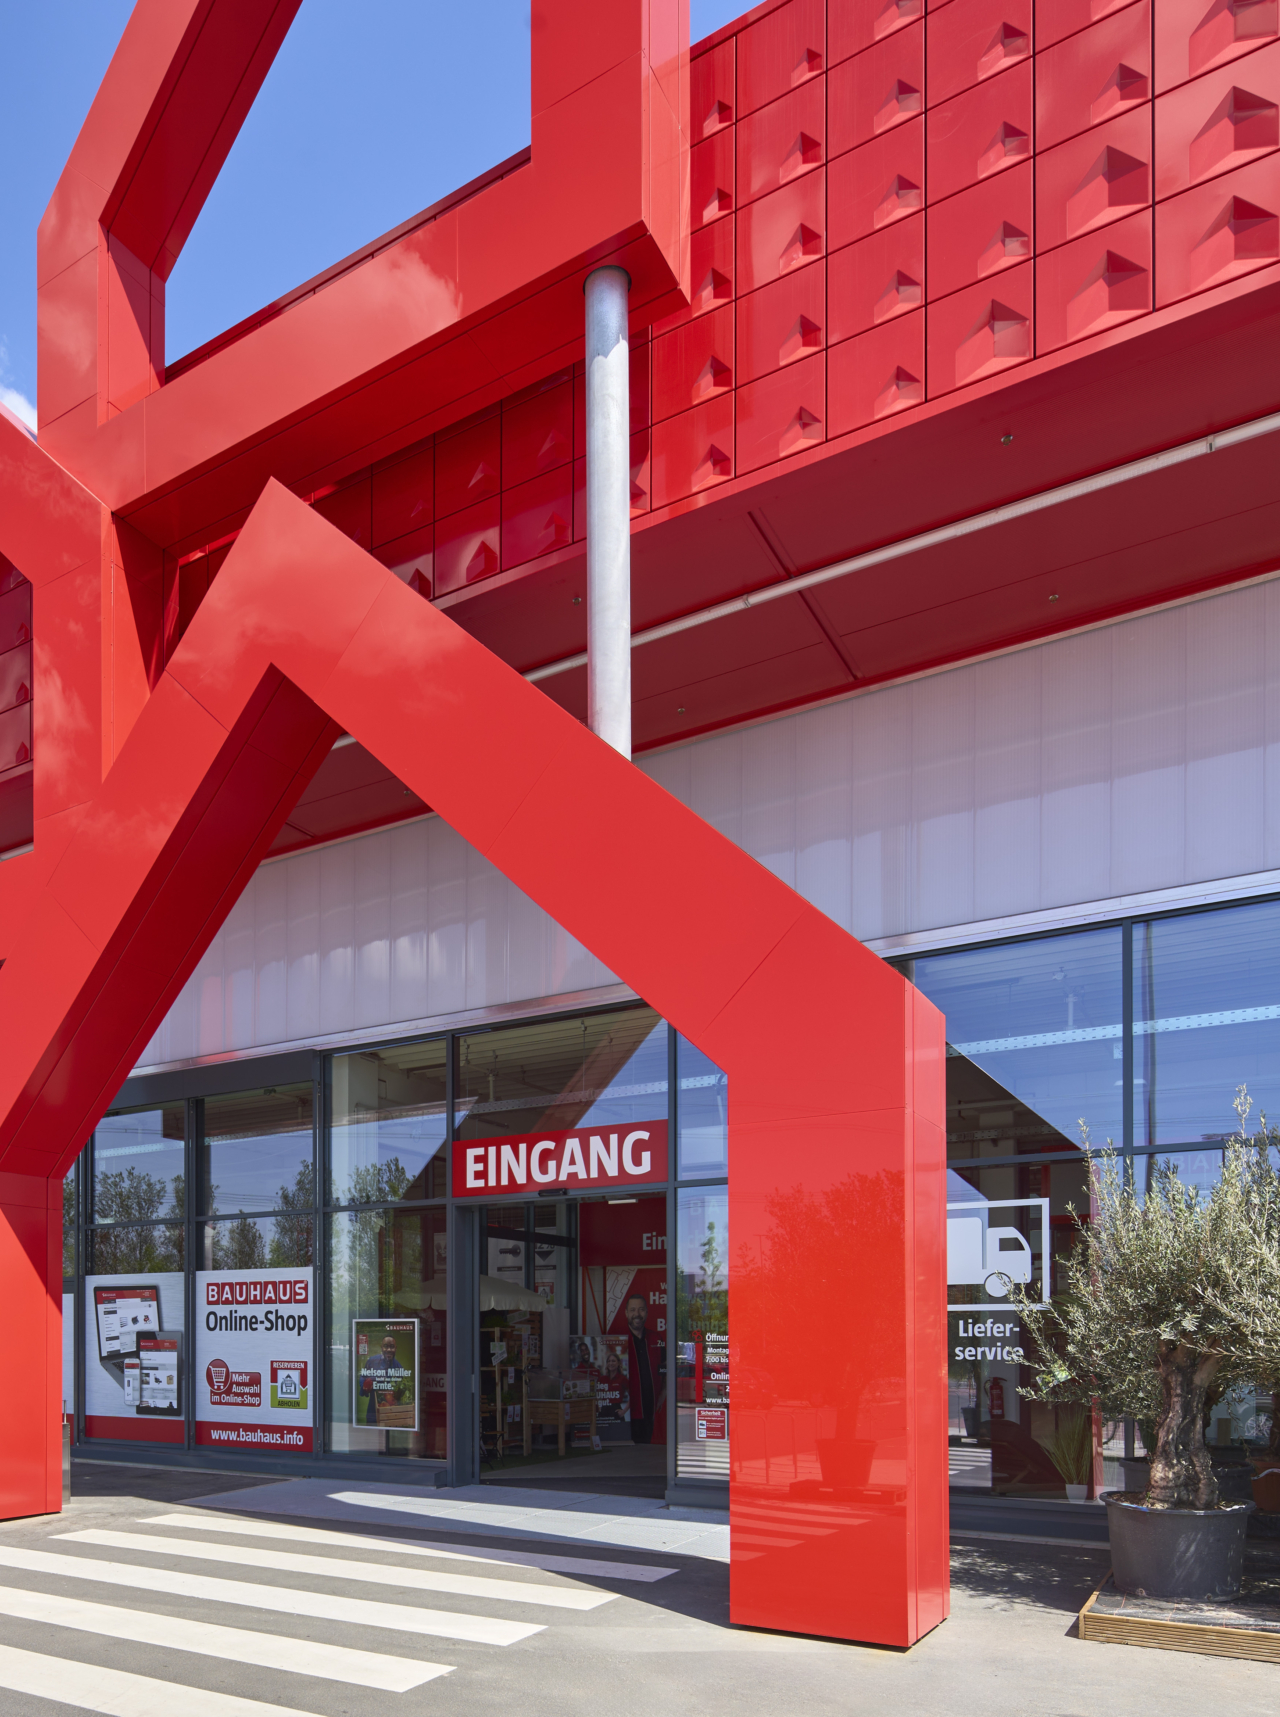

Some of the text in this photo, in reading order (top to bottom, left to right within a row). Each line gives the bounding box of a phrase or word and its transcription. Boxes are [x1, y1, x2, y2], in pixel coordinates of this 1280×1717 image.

[466, 1130, 651, 1188] EINGANG
[207, 1283, 307, 1302] BAUHAUS
[205, 1308, 308, 1337] Online-Shop
[958, 1318, 1020, 1337] Liefer-
[954, 1342, 1024, 1361] service
[231, 1373, 250, 1383] Mehr
[361, 1367, 412, 1377] Nelson Müller
[231, 1384, 260, 1394] Auswahl
[372, 1381, 394, 1390] Ernte.
[211, 1394, 261, 1406] im Online-Shop
[210, 1428, 304, 1445] www.bauhaus.info
